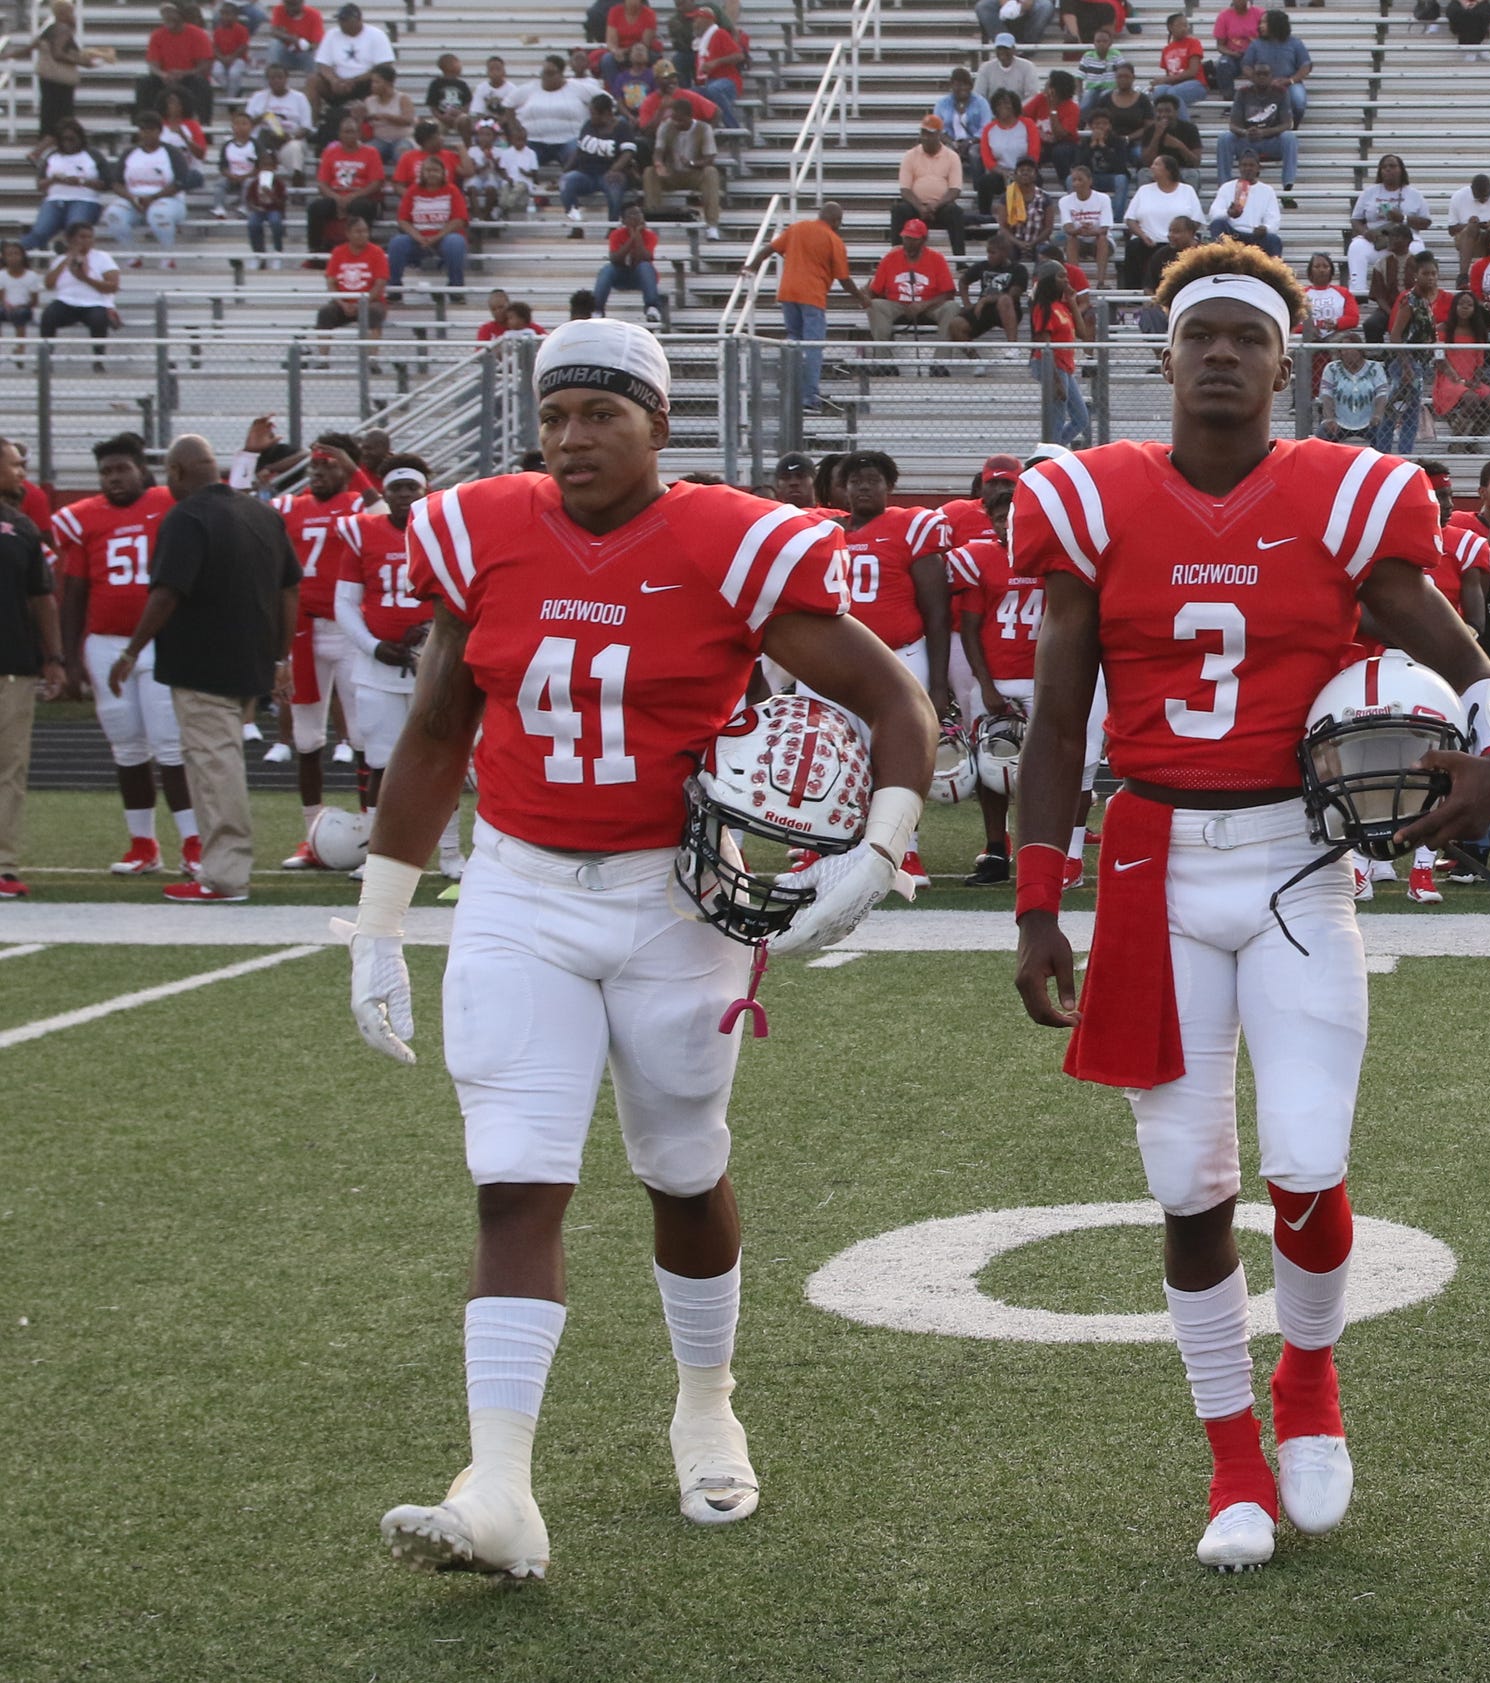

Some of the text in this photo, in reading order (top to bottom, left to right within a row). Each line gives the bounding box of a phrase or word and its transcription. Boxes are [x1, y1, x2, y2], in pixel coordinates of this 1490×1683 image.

[541, 367, 660, 409] COMBAT NIKE
[107, 535, 151, 585] 51
[302, 527, 327, 577] 7
[1171, 564, 1258, 585] RICHWOOD
[540, 600, 627, 626] RICHWOOD
[996, 589, 1043, 640] 44
[1165, 602, 1246, 741] 3
[516, 636, 637, 785] 41
[1355, 705, 1392, 720] Riddell
[763, 810, 812, 833] Riddell
[846, 889, 880, 933] adizero
